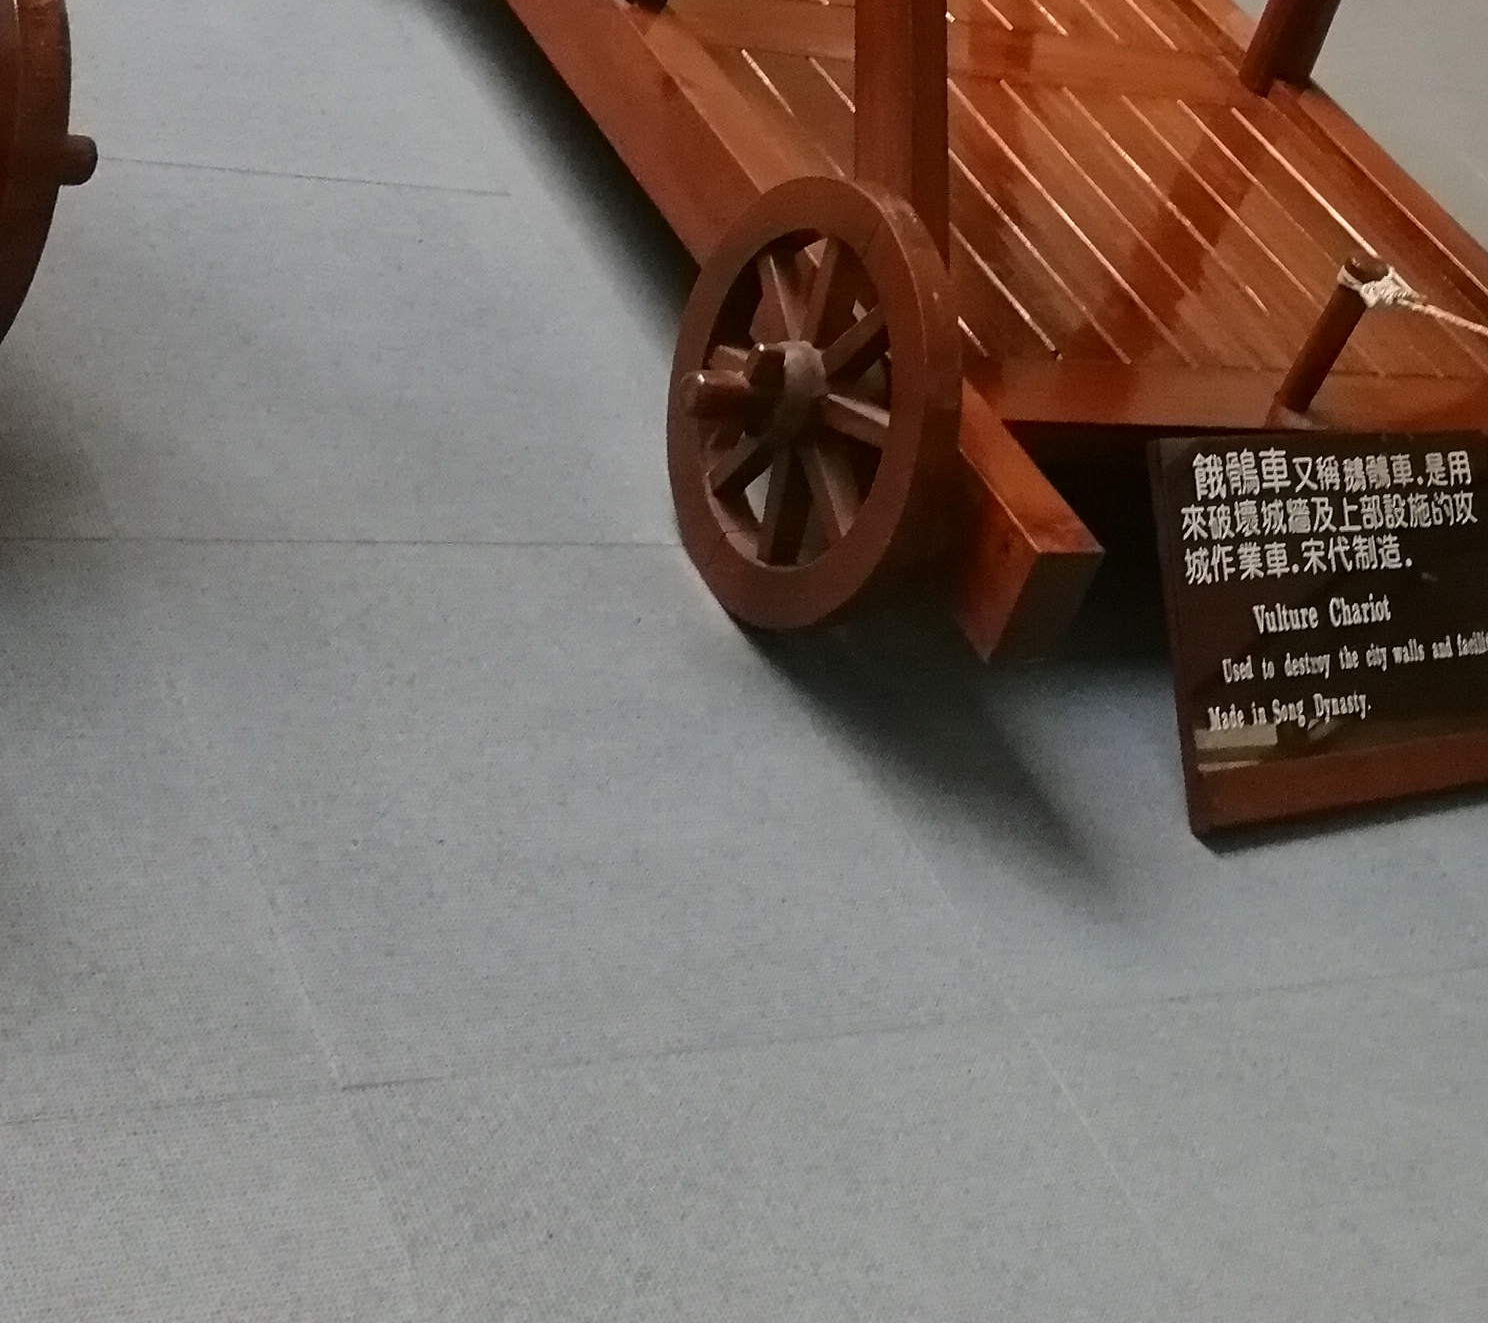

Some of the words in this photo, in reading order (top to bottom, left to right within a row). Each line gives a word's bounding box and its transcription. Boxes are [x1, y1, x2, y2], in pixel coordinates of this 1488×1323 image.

[1252, 602, 1319, 635] Vulture
[1328, 593, 1392, 628] Chariot
[1221, 654, 1254, 684] Used
[1261, 657, 1275, 680] to
[1284, 652, 1331, 680] destroy
[1338, 645, 1360, 670] the
[1365, 642, 1387, 672] city
[1391, 638, 1425, 664] walls
[1431, 635, 1454, 660] and
[1207, 703, 1245, 732] Made
[1251, 701, 1267, 726] in
[1271, 698, 1306, 728] Song
[1312, 691, 1372, 725] Dynasty.
